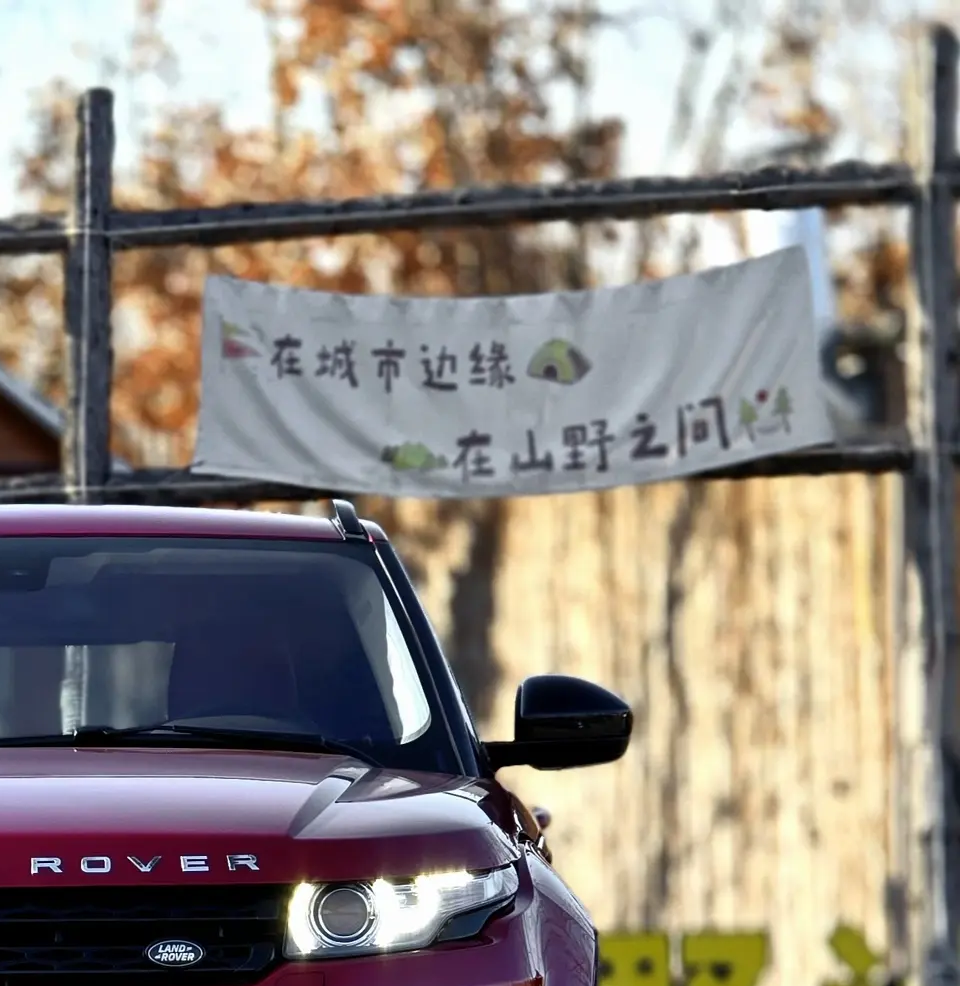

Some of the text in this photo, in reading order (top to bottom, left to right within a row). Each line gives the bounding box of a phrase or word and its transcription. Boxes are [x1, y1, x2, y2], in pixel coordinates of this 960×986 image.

[269, 333, 517, 393] 在城市边缘
[451, 396, 730, 479] 在山野之间
[30, 853, 261, 875] ROVER
[158, 944, 186, 953] LAND
[160, 952, 195, 962] ROVER
